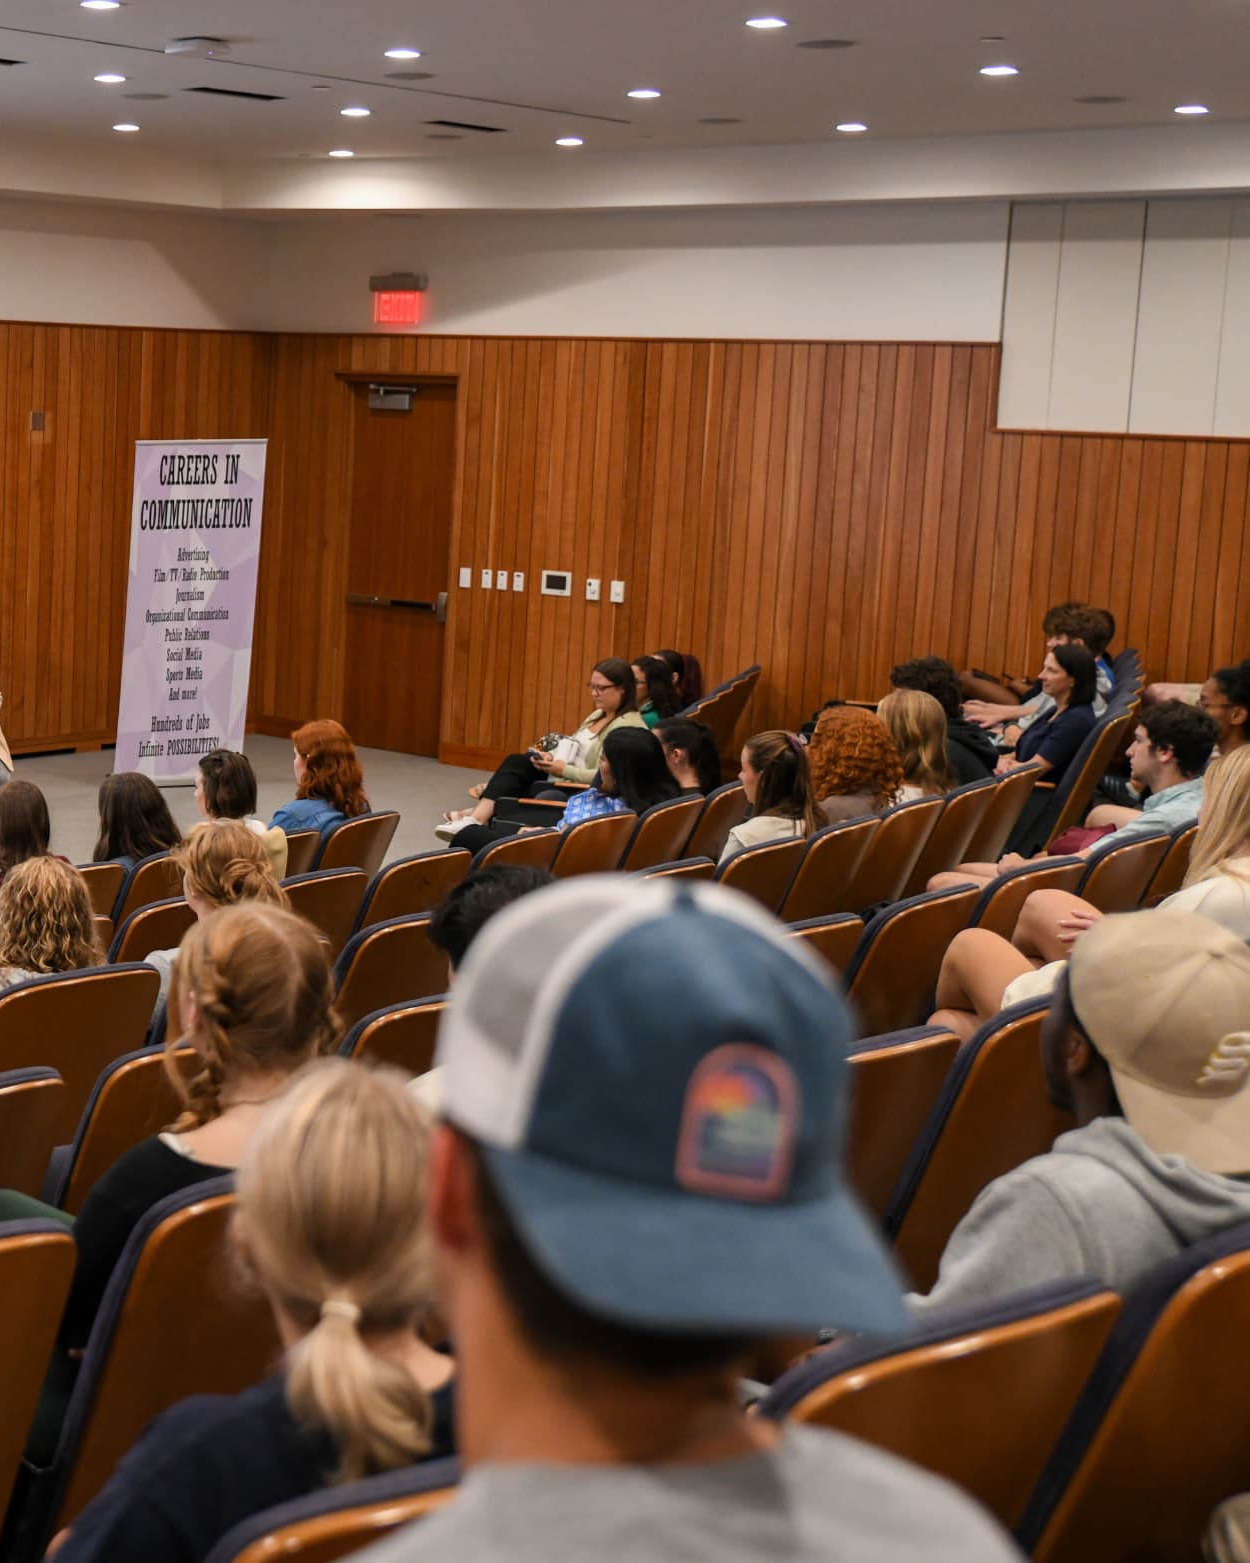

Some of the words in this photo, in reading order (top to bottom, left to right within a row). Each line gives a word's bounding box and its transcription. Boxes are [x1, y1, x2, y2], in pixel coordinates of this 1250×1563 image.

[380, 293, 415, 321] EXIT
[159, 454, 218, 486] CAREERS
[224, 454, 240, 485] IN
[140, 498, 253, 531] COMMUNICATION
[177, 548, 210, 562] Advertising
[199, 567, 230, 580] Production
[175, 588, 204, 604] Journalism
[146, 608, 186, 624] Organizational
[186, 608, 229, 620] Communication
[164, 628, 183, 642] Public
[184, 628, 210, 641] Relations
[166, 648, 184, 662] Social
[184, 648, 202, 661] Media
[166, 668, 184, 682] Sports
[184, 668, 202, 680] Media
[168, 688, 180, 701] And
[180, 688, 198, 701] more!
[151, 716, 183, 732] Hundreds
[185, 714, 194, 730] of
[196, 714, 210, 730] Jobs
[138, 741, 164, 758] Infinite
